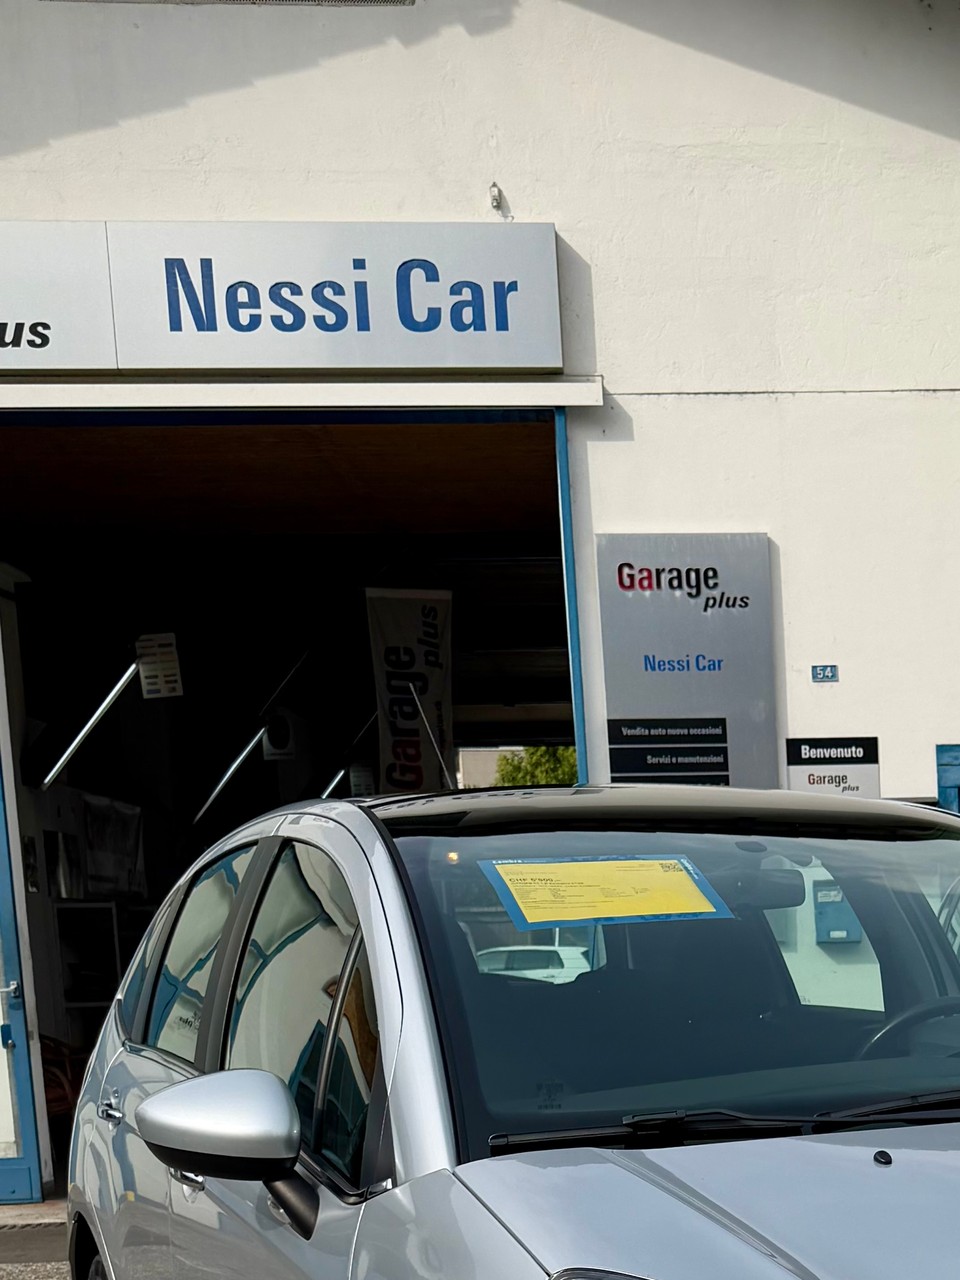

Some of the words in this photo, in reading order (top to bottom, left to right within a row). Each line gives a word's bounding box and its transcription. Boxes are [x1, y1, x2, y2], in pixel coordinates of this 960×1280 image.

[164, 257, 371, 333] Nessi
[395, 257, 519, 333] Car
[617, 562, 719, 598] Garage
[703, 592, 750, 612] plus
[417, 604, 443, 669] plus
[644, 654, 690, 672] Nessi
[695, 654, 724, 672] Car
[816, 666, 833, 679] 54
[384, 645, 428, 791] Garage
[621, 726, 649, 736] Vendita
[650, 727, 666, 736] auto
[689, 726, 722, 735] occasioni
[646, 755, 671, 764] Servizi
[677, 754, 724, 763] manutenzioni
[801, 744, 864, 759] Benvenuto
[808, 773, 848, 788] Garage
[842, 784, 860, 793] plus
